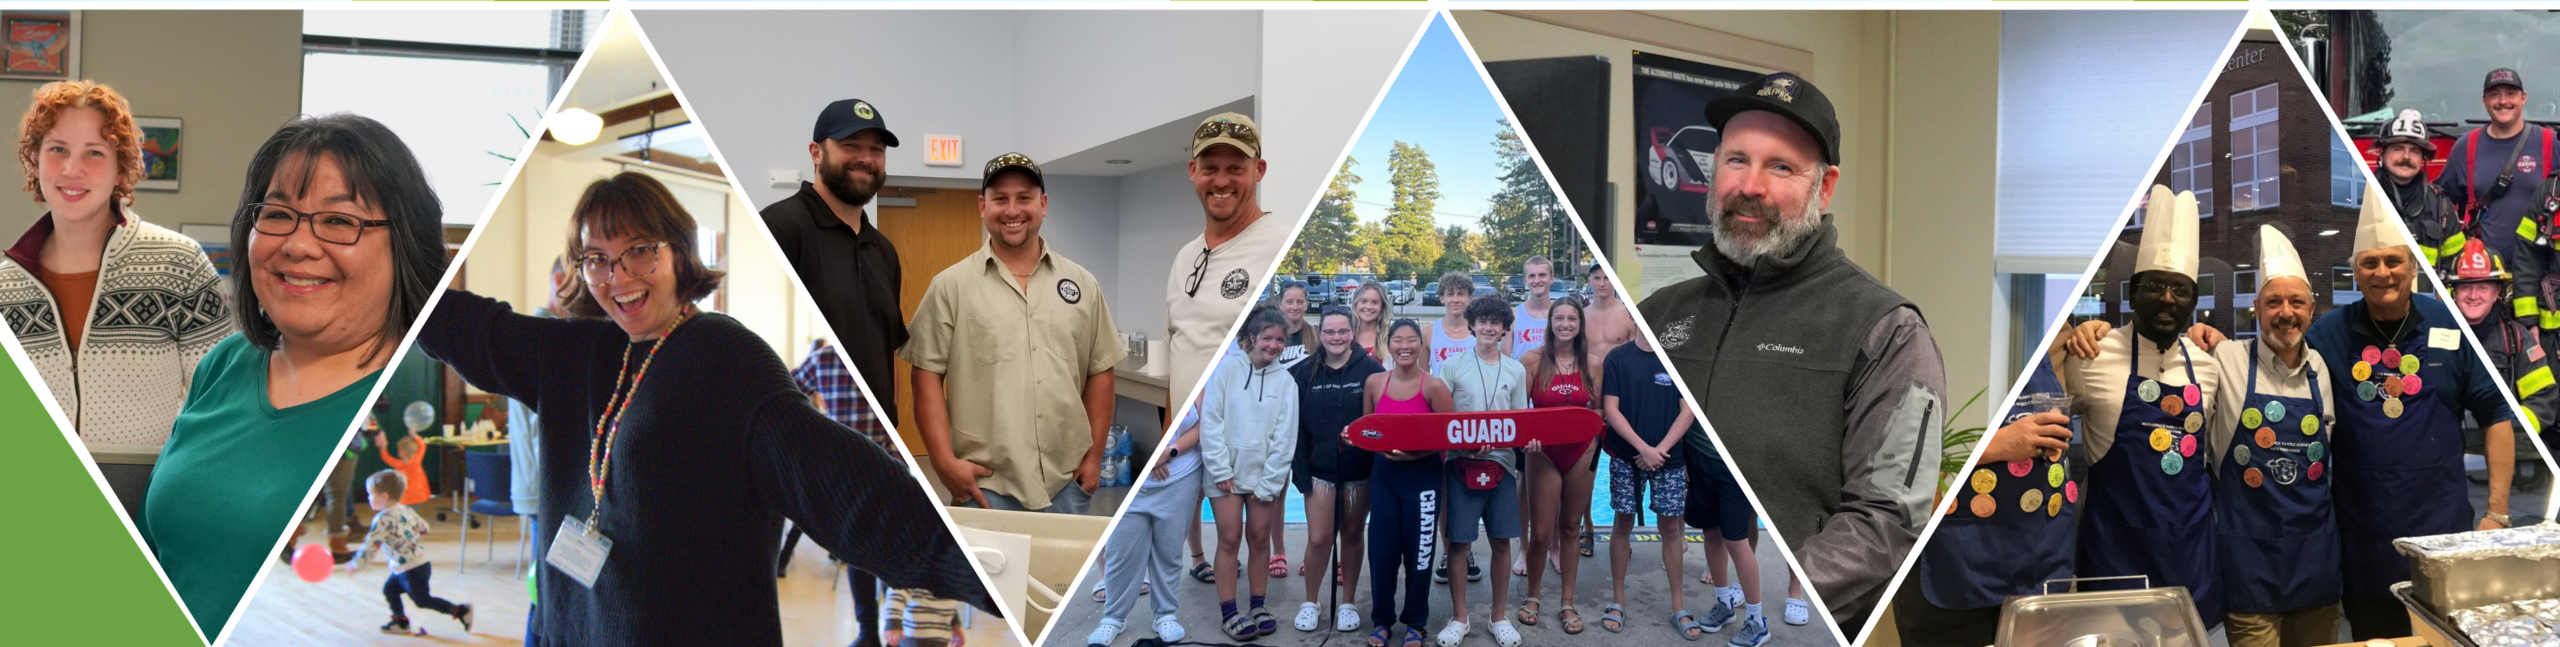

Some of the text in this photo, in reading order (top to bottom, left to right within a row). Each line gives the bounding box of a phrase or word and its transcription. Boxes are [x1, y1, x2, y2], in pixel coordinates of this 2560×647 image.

[2221, 47, 2265, 73] enter
[1641, 66, 1650, 75] THE
[1651, 68, 1672, 79] ALTERNATE
[931, 138, 958, 161] EXIT
[2461, 253, 2485, 269] 19
[1765, 343, 1804, 355] Columbia
[1552, 383, 1579, 391] GUARD
[1447, 418, 1516, 444] GUARD
[1417, 489, 1436, 570] CHATHAM
